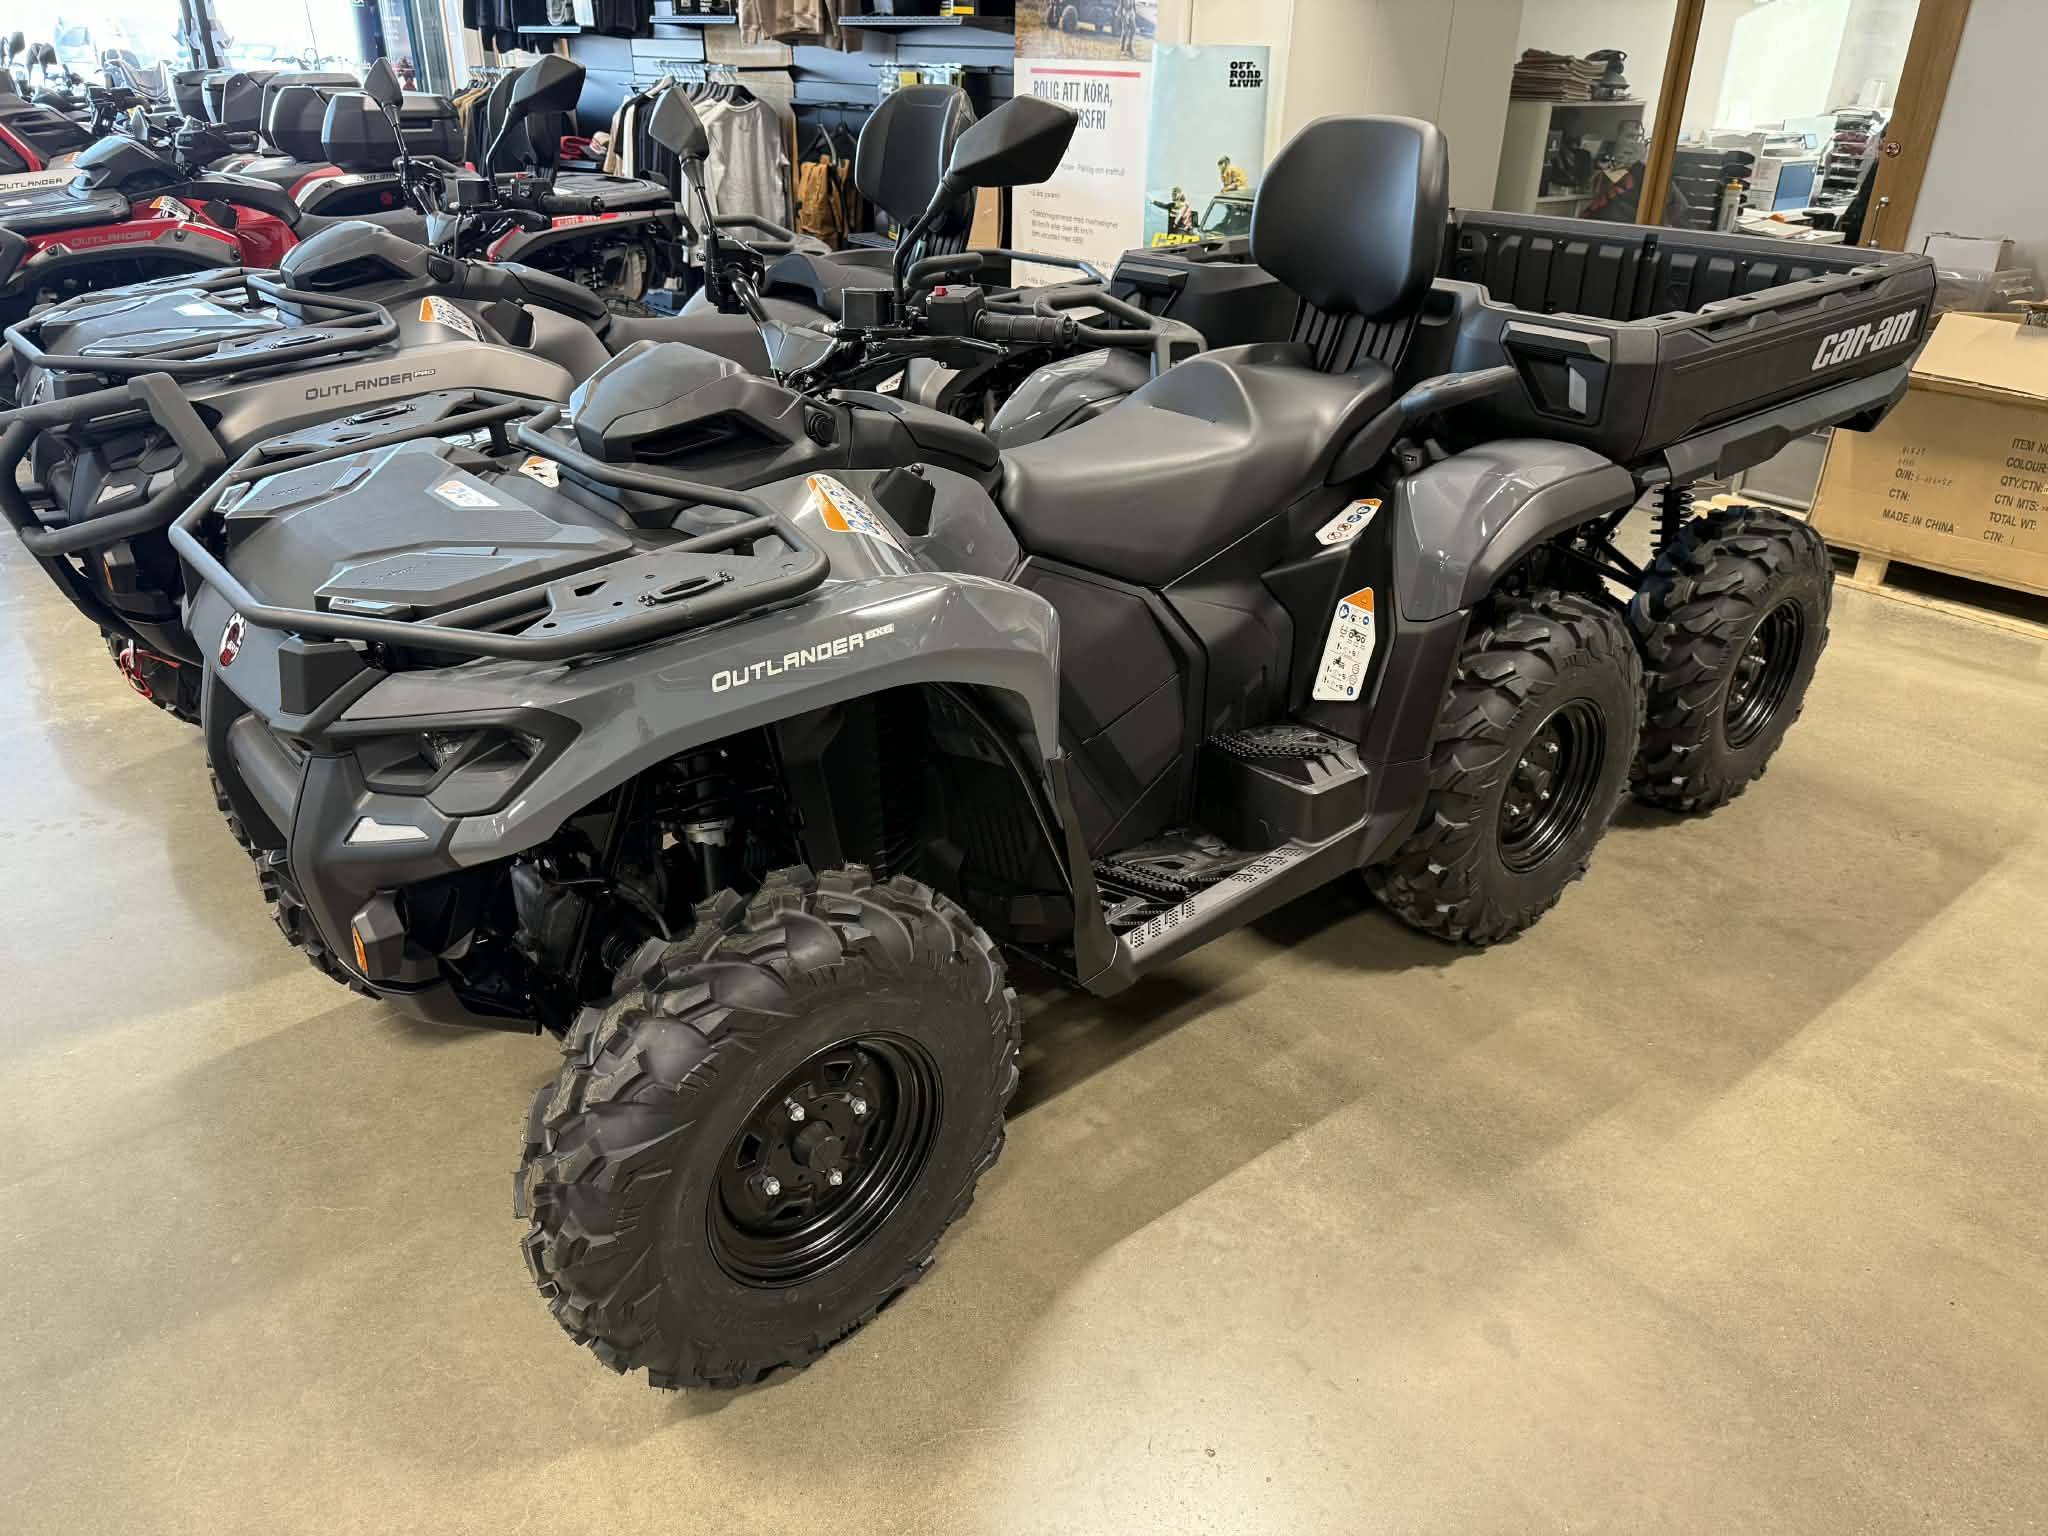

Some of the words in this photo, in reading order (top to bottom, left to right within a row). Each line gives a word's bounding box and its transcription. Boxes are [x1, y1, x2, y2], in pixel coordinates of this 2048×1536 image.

[1230, 61, 1256, 70] OFF-
[1230, 70, 1261, 79] ROAD
[1062, 81, 1081, 102] ATT
[1083, 80, 1113, 107] KÖRA,
[71, 230, 152, 247] OUTLANDER
[1811, 308, 1918, 371] can-am
[305, 372, 413, 401] OUTLANDER
[2011, 438, 2036, 452] ITEM
[1888, 488, 1911, 502] CTN:
[1994, 494, 2014, 507] CTN
[1882, 508, 1911, 524] MADE
[1911, 515, 1922, 526] IN
[1924, 518, 1955, 534] CHINA
[1989, 511, 2017, 527] TOTAL
[1983, 529, 2005, 544] CTN:
[711, 632, 864, 693] OUTLANDER
